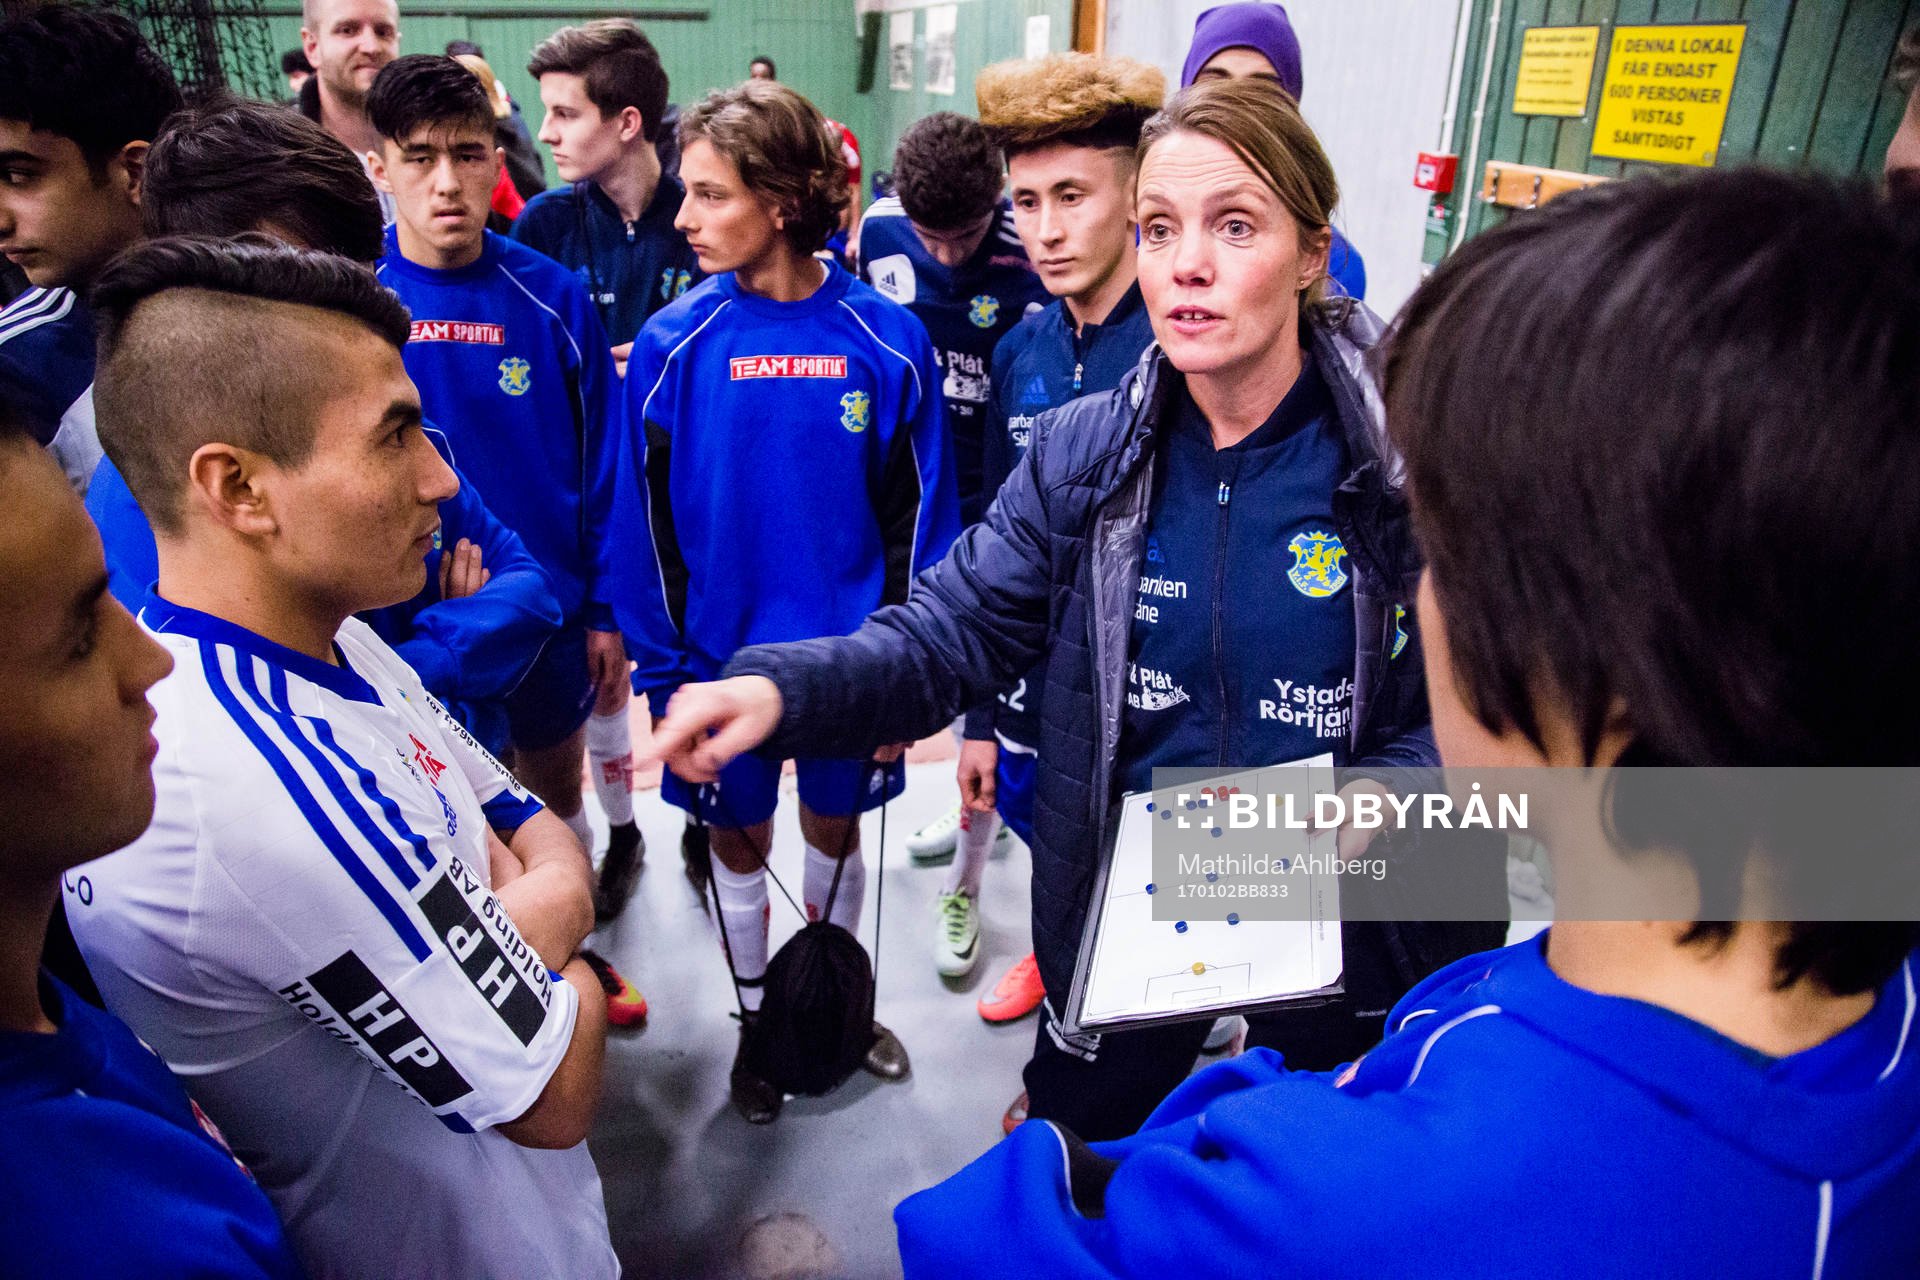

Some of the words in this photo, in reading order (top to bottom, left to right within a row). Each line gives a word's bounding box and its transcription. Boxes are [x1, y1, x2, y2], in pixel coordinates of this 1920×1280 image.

[1615, 39, 1621, 53] I
[1624, 39, 1675, 53] DENNA
[1681, 39, 1734, 54] LOKAL
[1622, 59, 1649, 77] FÅR
[1653, 62, 1718, 78] ENDAST
[1609, 84, 1634, 98] 600
[1637, 85, 1722, 104] PERSONER
[1632, 109, 1685, 126] VISTAS
[1613, 130, 1696, 151] SAMTIDIGT
[408, 322, 449, 341] EAM
[453, 326, 502, 344] SPORTIA
[732, 358, 788, 377] TEAM
[793, 358, 843, 376] SPORTIA
[1140, 667, 1174, 689] Plåt
[1273, 677, 1354, 704] Ystads
[450, 856, 480, 895] AB
[447, 925, 518, 1009] HP
[347, 990, 440, 1068] HP
